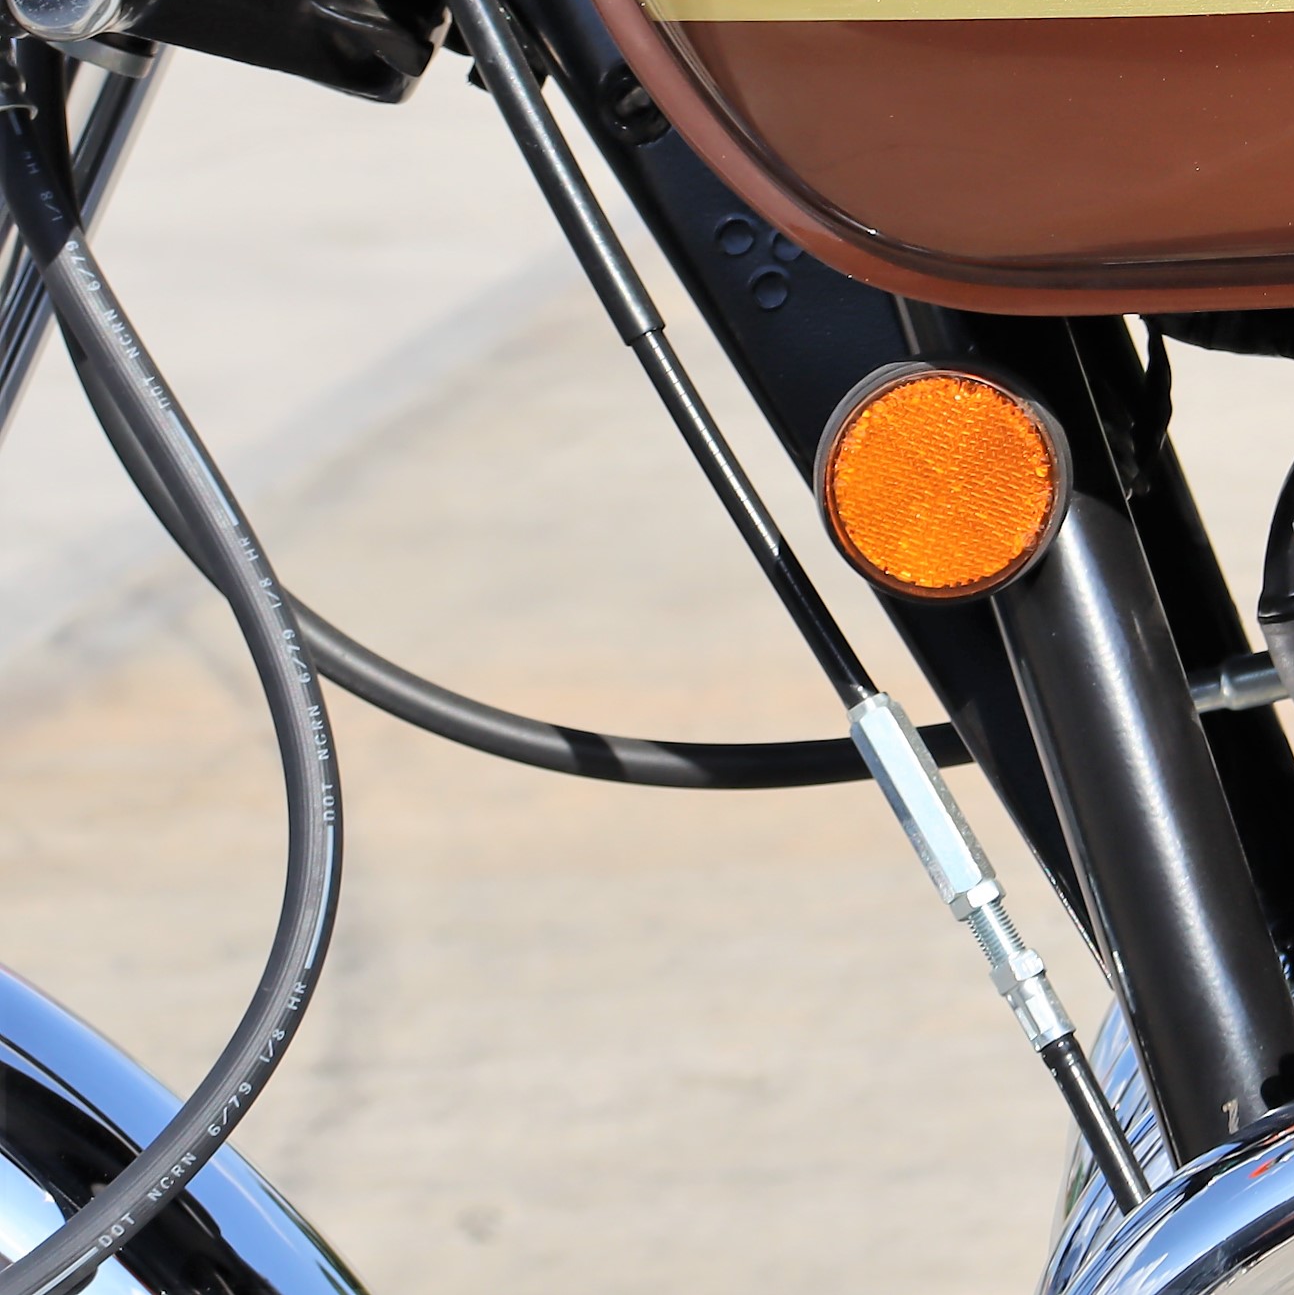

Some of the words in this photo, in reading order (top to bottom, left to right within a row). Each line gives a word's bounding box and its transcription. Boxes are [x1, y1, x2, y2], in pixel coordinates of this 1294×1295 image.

[65, 240, 101, 292] 6/79
[238, 537, 259, 561] HR
[282, 628, 311, 684] 6/79
[308, 704, 329, 760] NCRN
[321, 782, 335, 822] DOT
[98, 1212, 135, 1248] DOT
[146, 1152, 197, 1202] NCRN
[207, 1081, 252, 1137] 6/79
[259, 1028, 286, 1063] 1/8
[286, 981, 307, 1011] HR
